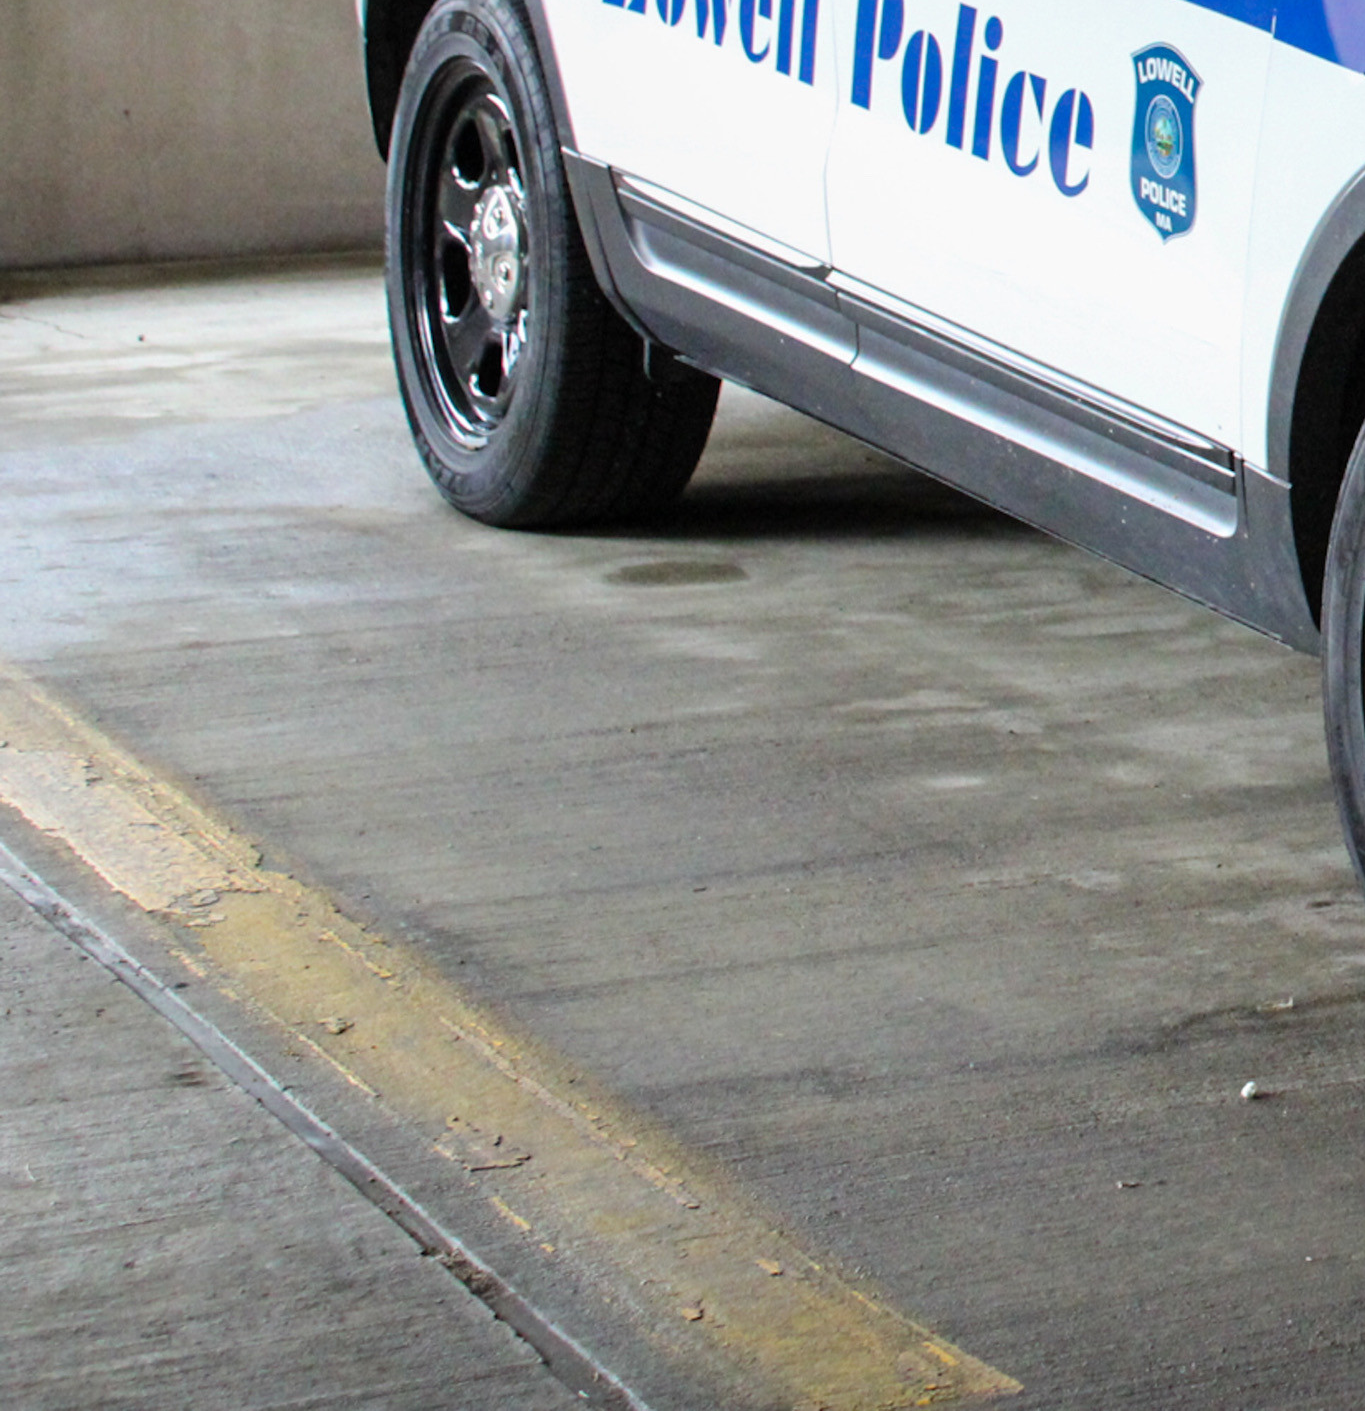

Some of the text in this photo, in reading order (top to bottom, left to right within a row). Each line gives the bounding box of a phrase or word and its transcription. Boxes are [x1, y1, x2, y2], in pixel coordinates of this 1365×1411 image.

[1137, 57, 1195, 104] LOWELL
[1140, 176, 1187, 218] POLICE
[1155, 211, 1173, 233] MA
